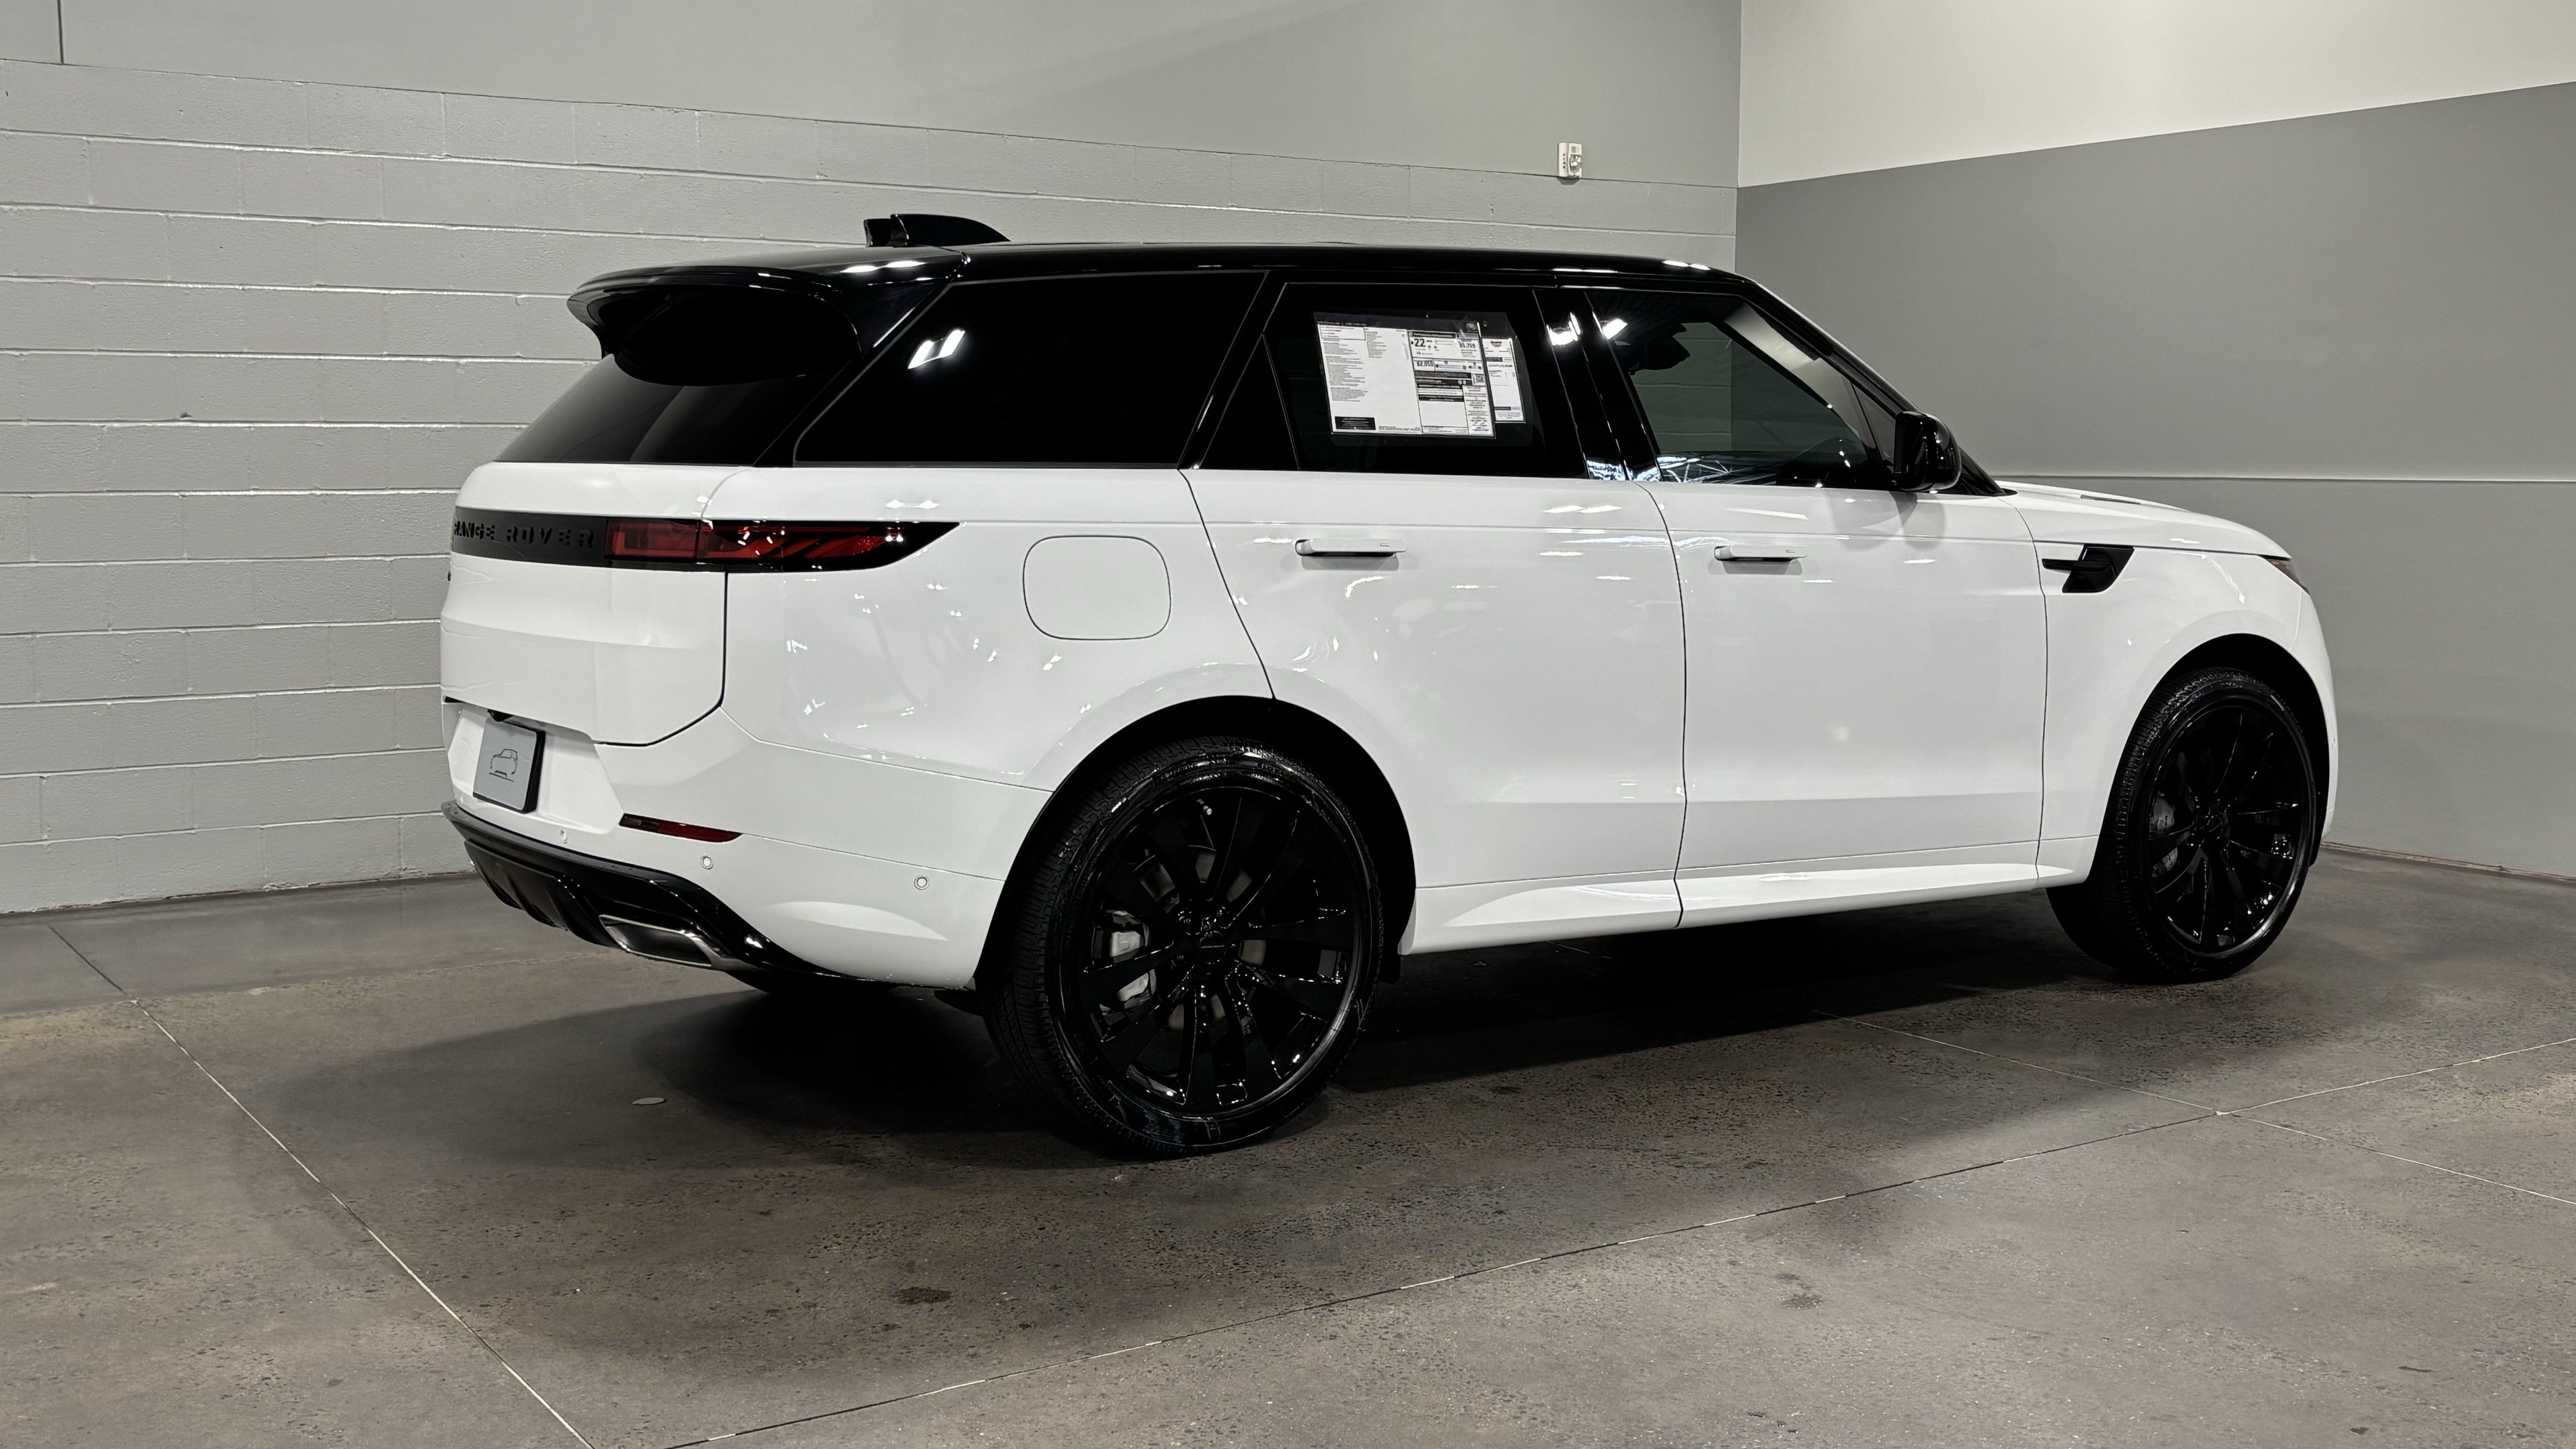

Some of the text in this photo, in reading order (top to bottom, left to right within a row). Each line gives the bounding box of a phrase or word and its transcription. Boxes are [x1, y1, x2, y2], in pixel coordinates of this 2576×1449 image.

[1414, 338, 1426, 347] 22
[454, 520, 594, 548] RANGE ROVER
